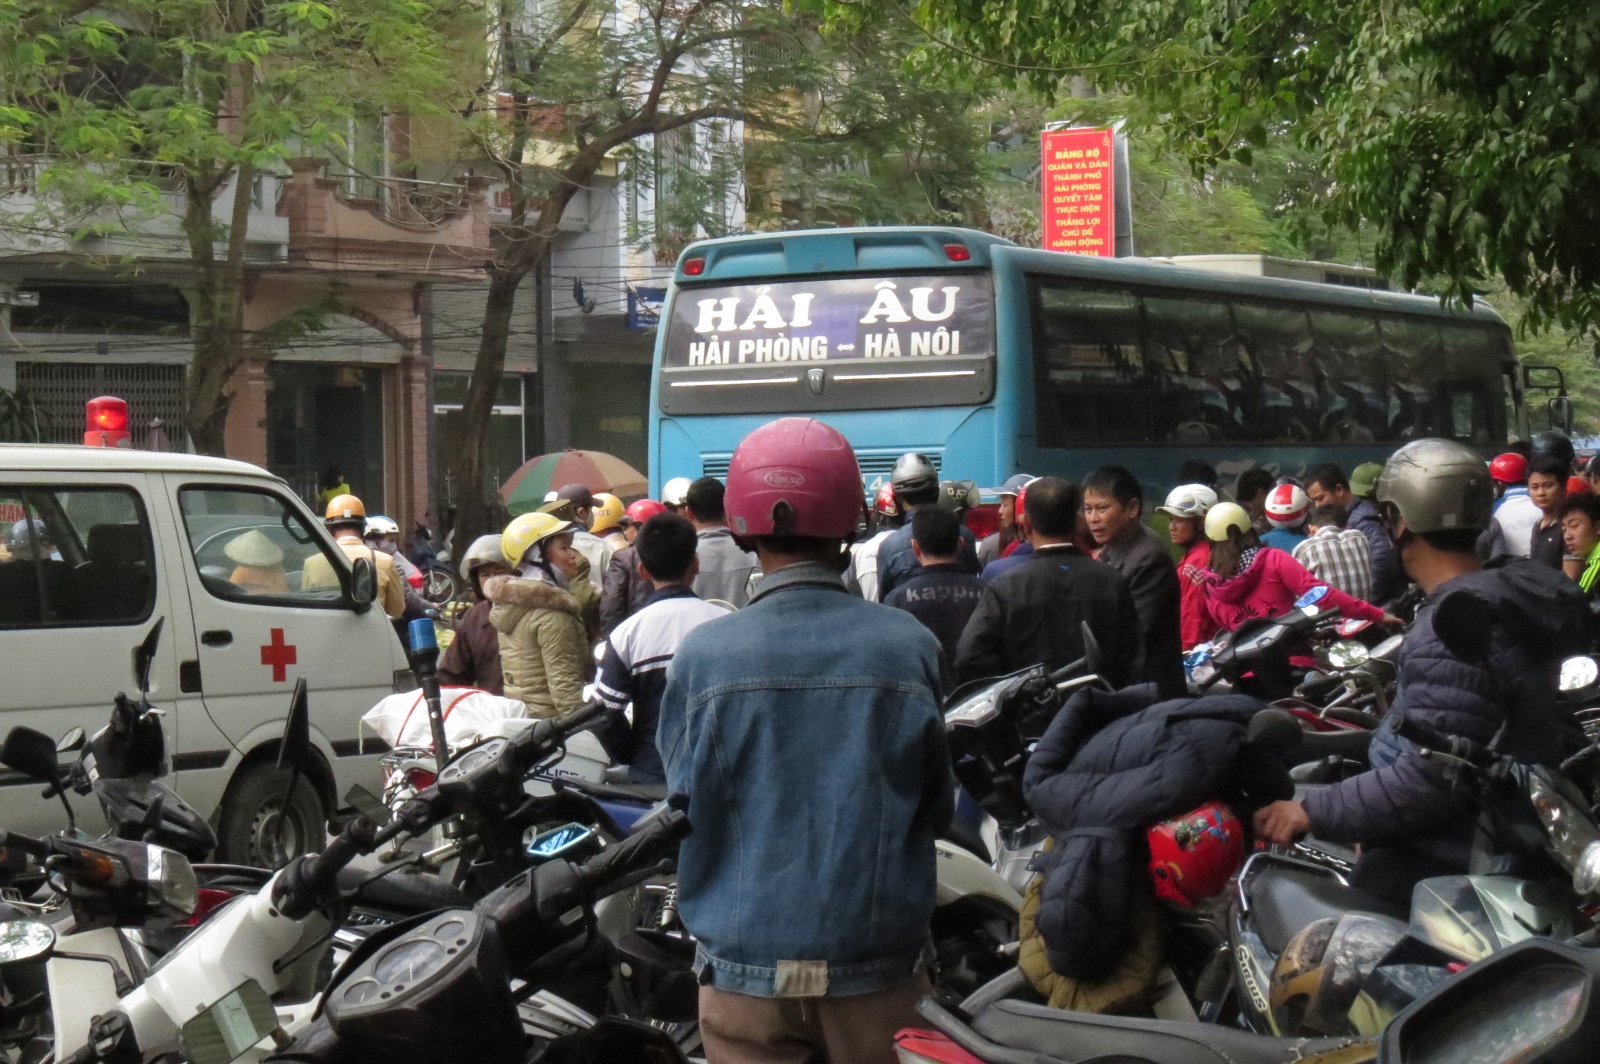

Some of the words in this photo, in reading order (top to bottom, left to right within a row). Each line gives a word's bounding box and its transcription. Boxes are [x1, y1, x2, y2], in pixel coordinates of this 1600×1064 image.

[1086, 148, 1099, 158] BỘ
[694, 286, 814, 333] HẢI
[860, 281, 961, 324] ÂU
[689, 335, 730, 366] HẢI
[738, 332, 828, 364] PHÒNG
[864, 327, 901, 358] HÀ
